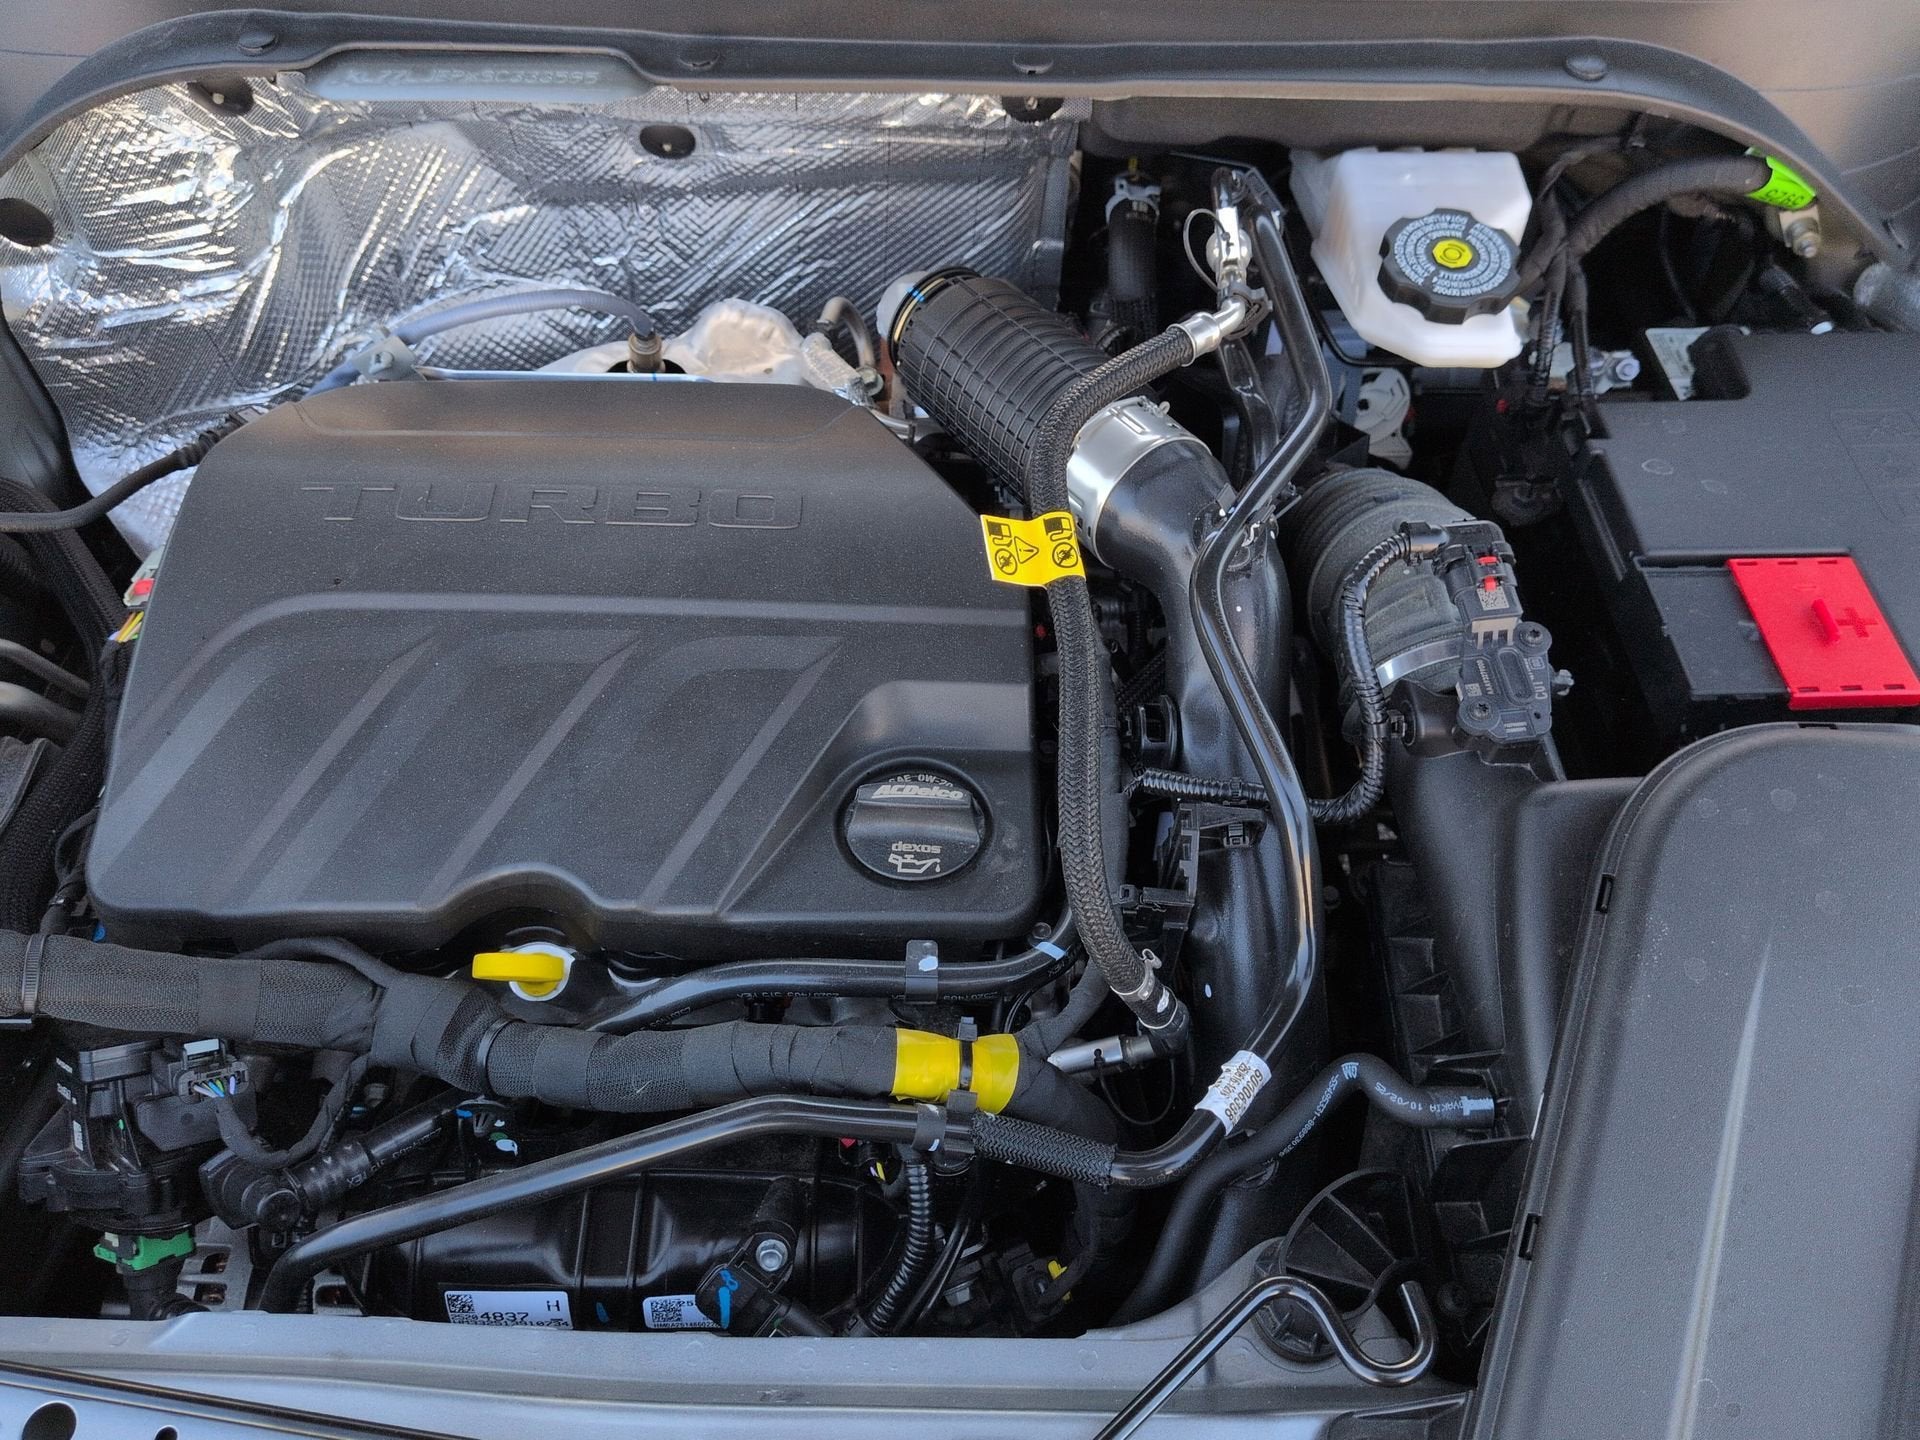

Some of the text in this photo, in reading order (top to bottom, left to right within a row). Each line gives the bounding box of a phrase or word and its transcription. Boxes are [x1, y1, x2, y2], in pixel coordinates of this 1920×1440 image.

[300, 482, 804, 530] TURBO
[872, 785, 964, 799] ACDelco
[892, 841, 942, 853] dexos
[1341, 1061, 1359, 1080] GM
[546, 1300, 561, 1312] H
